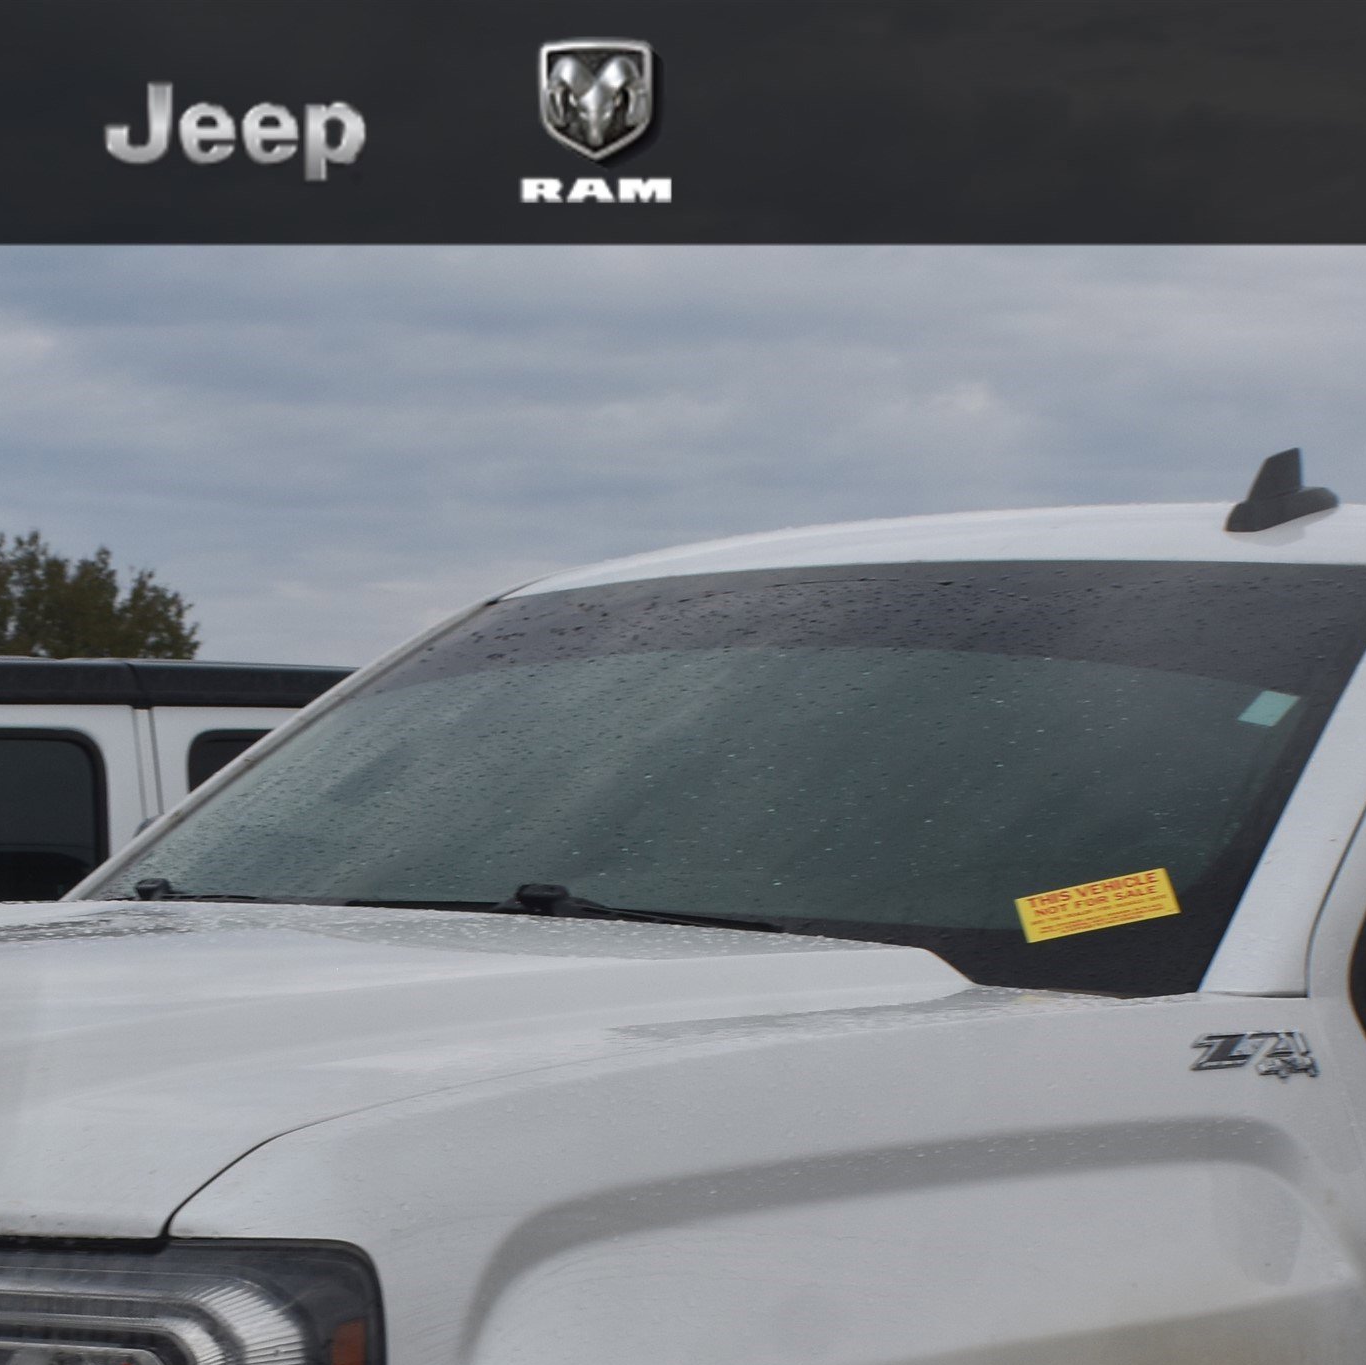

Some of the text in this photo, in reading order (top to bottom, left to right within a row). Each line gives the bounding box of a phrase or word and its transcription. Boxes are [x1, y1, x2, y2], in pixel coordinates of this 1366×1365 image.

[1027, 872, 1159, 908] THIS VEHICLE
[1035, 904, 1069, 916] NOT
[1074, 896, 1109, 909] FOR
[1115, 885, 1158, 901] SALE
[1190, 1031, 1311, 1071] Z71
